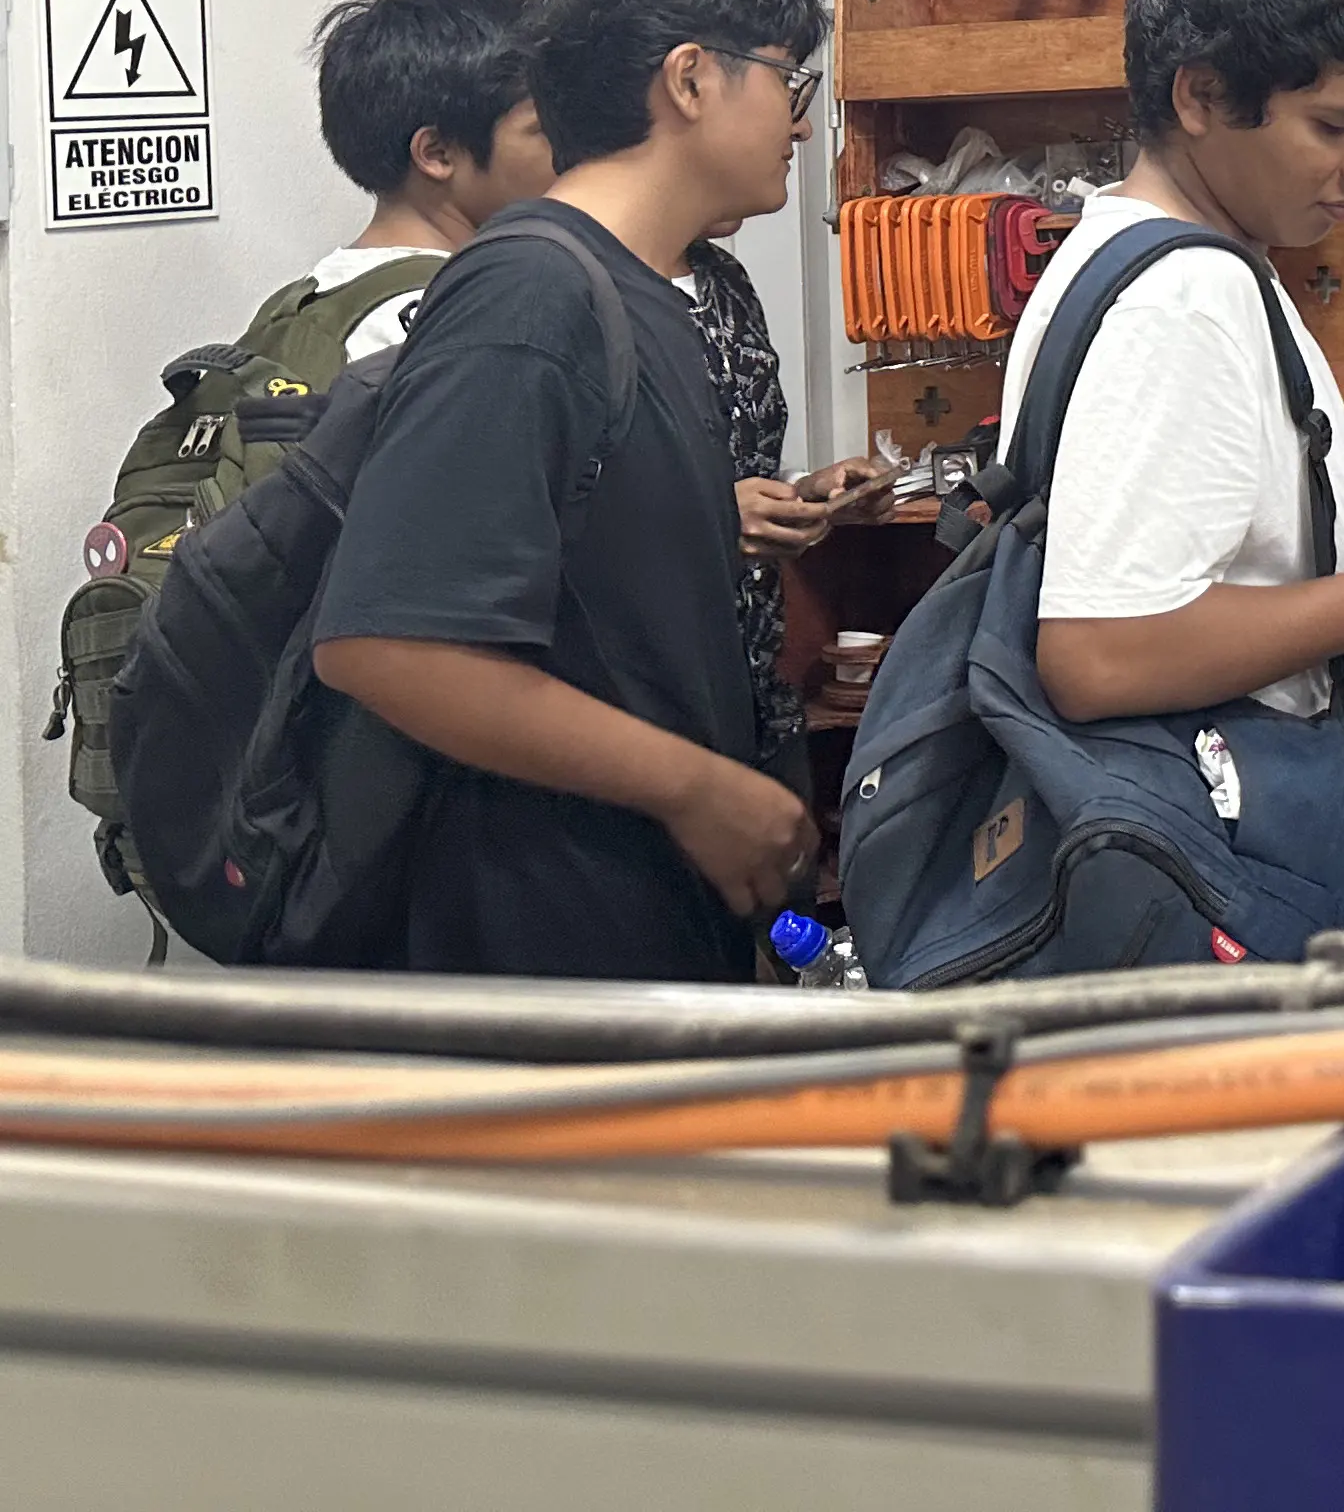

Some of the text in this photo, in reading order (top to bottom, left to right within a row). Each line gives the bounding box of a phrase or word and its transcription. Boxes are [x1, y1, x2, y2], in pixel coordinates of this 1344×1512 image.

[65, 134, 200, 168] ATENCION
[90, 166, 180, 188] RIESGO
[68, 186, 201, 211] ELÉCTRICO
